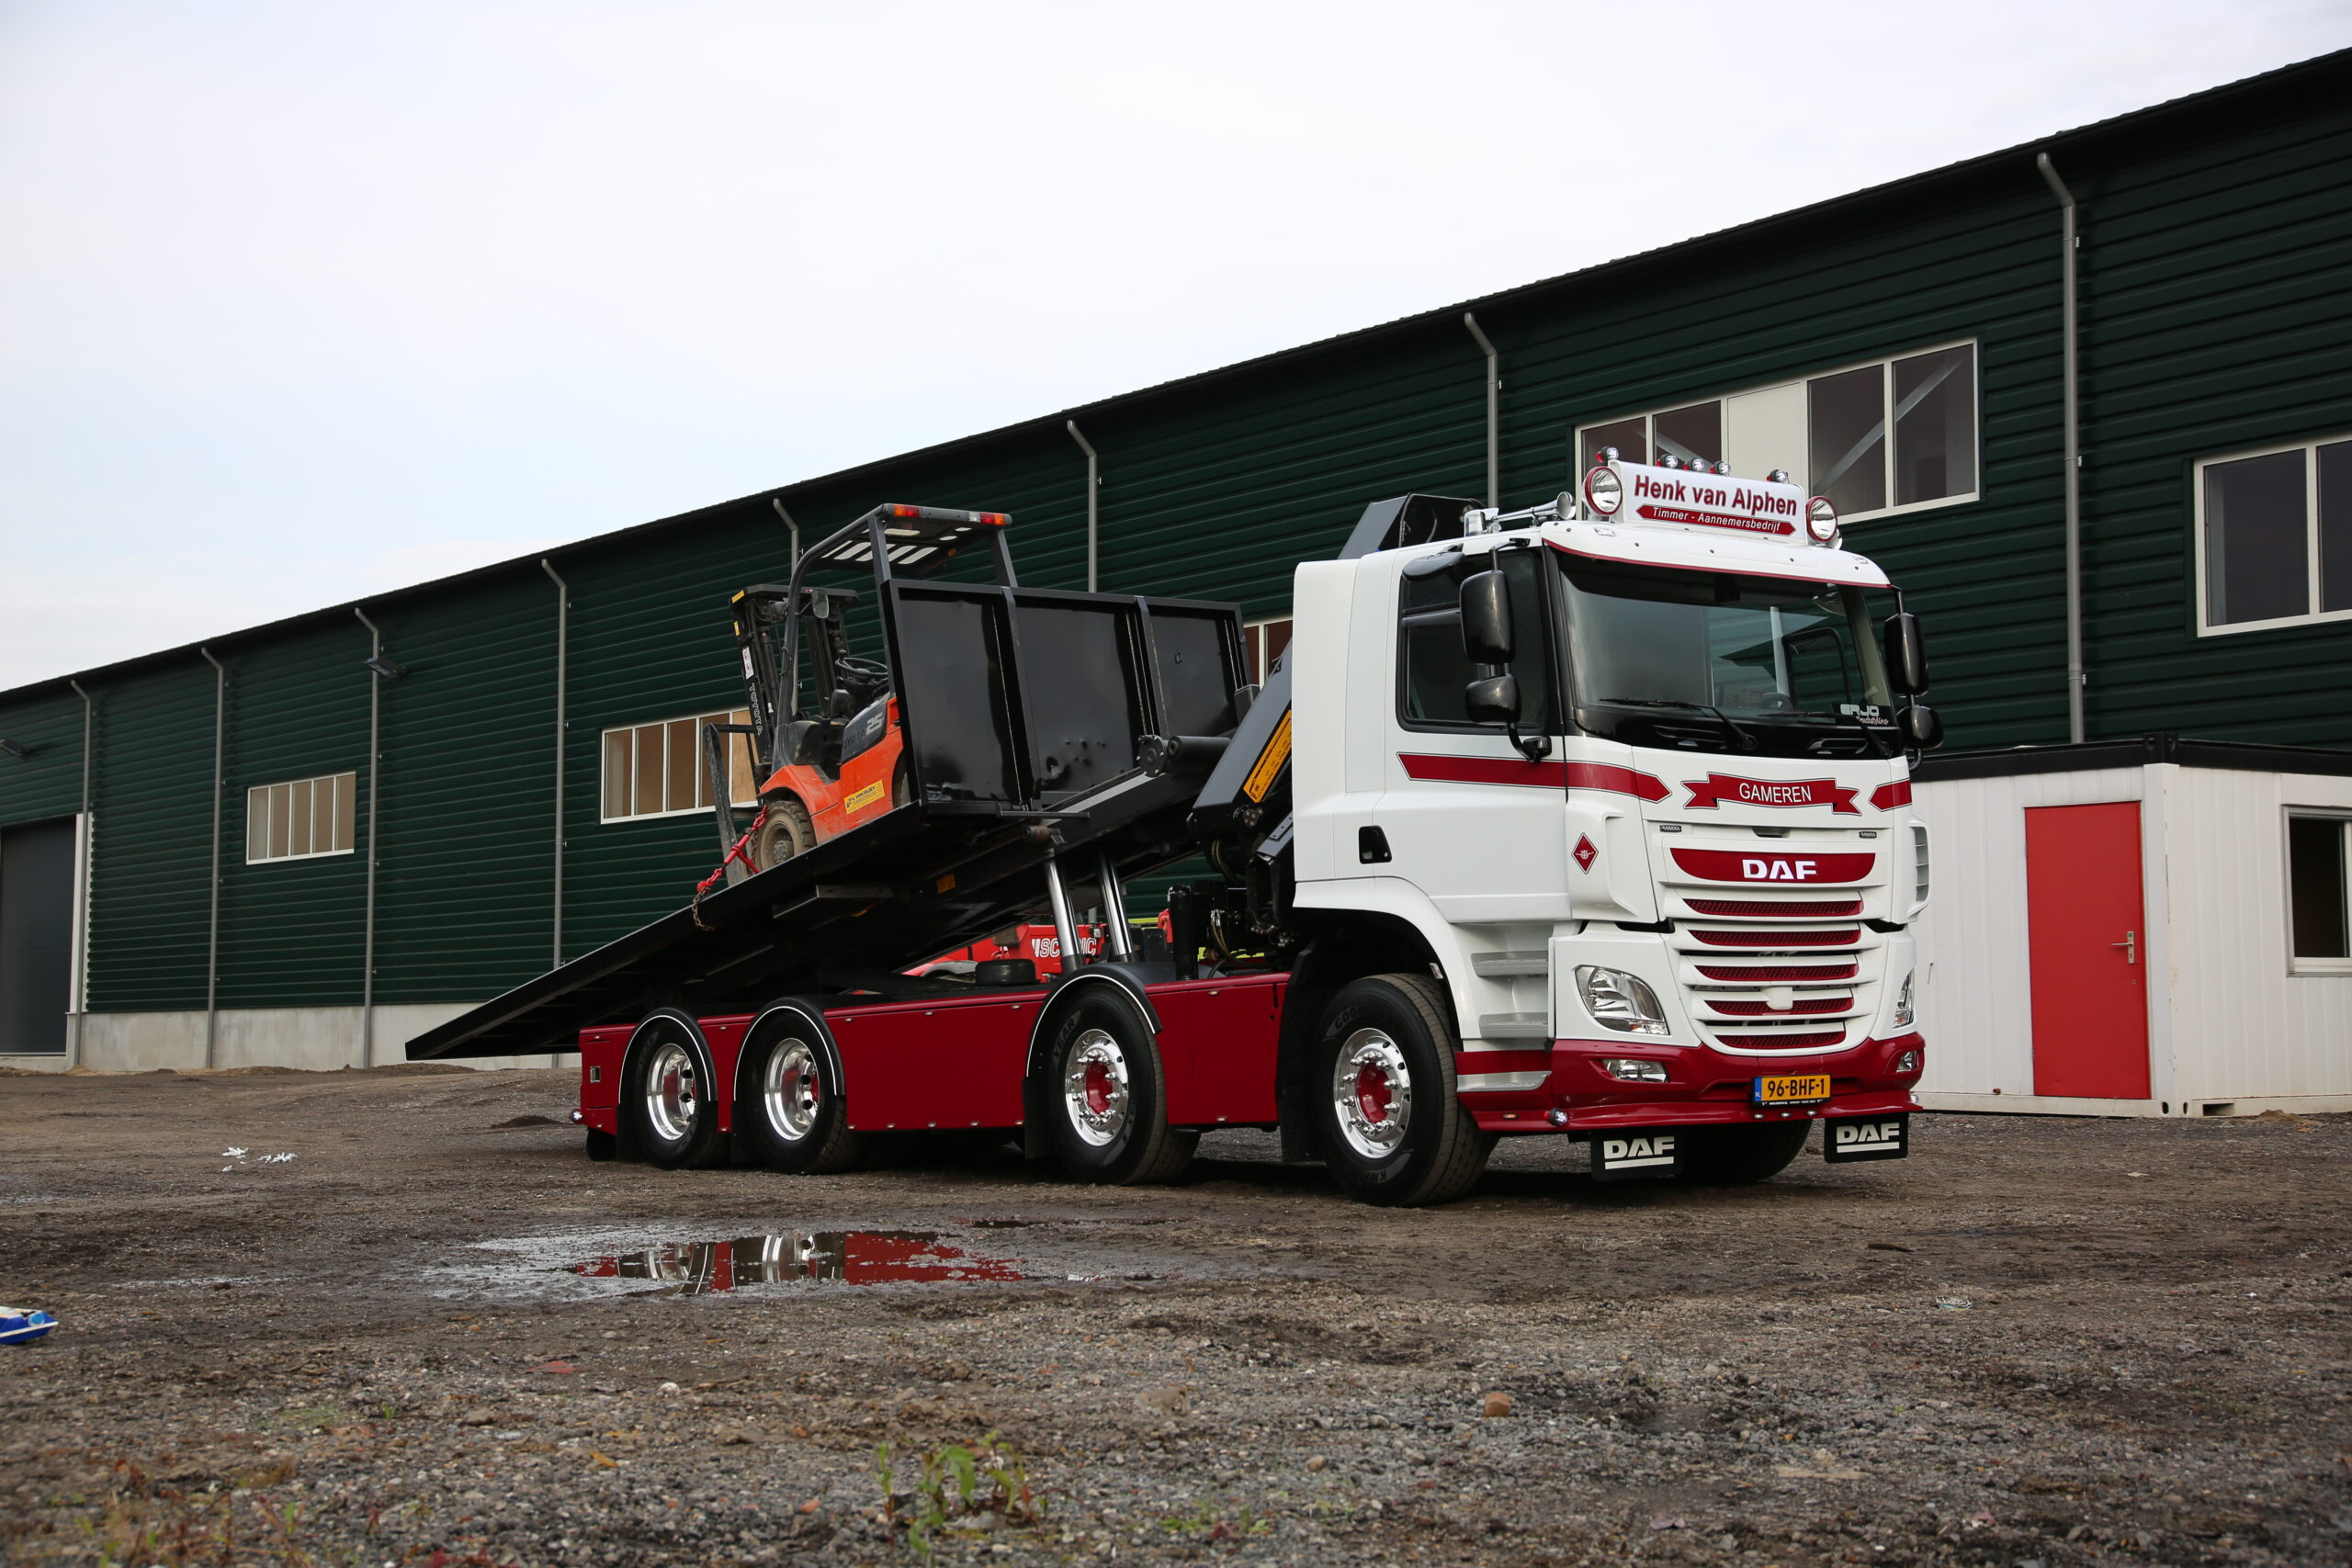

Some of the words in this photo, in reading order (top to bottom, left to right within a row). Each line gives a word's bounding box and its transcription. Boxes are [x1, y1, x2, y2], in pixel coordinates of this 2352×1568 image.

[1634, 474, 1687, 502] Henk
[1692, 486, 1727, 507] van
[1732, 487, 1797, 516] Alphen
[1653, 507, 1690, 521] Timmer
[1697, 513, 1781, 533] Aannemersbedrijf
[749, 682, 763, 736] TOYOTA
[866, 712, 885, 735] 25
[1739, 783, 1812, 803] GAMEREN
[1742, 859, 1817, 879] DAF
[1768, 1078, 1825, 1097] 96-BHF-1
[1838, 1122, 1900, 1144] DAF
[1603, 1136, 1675, 1159] DAF
